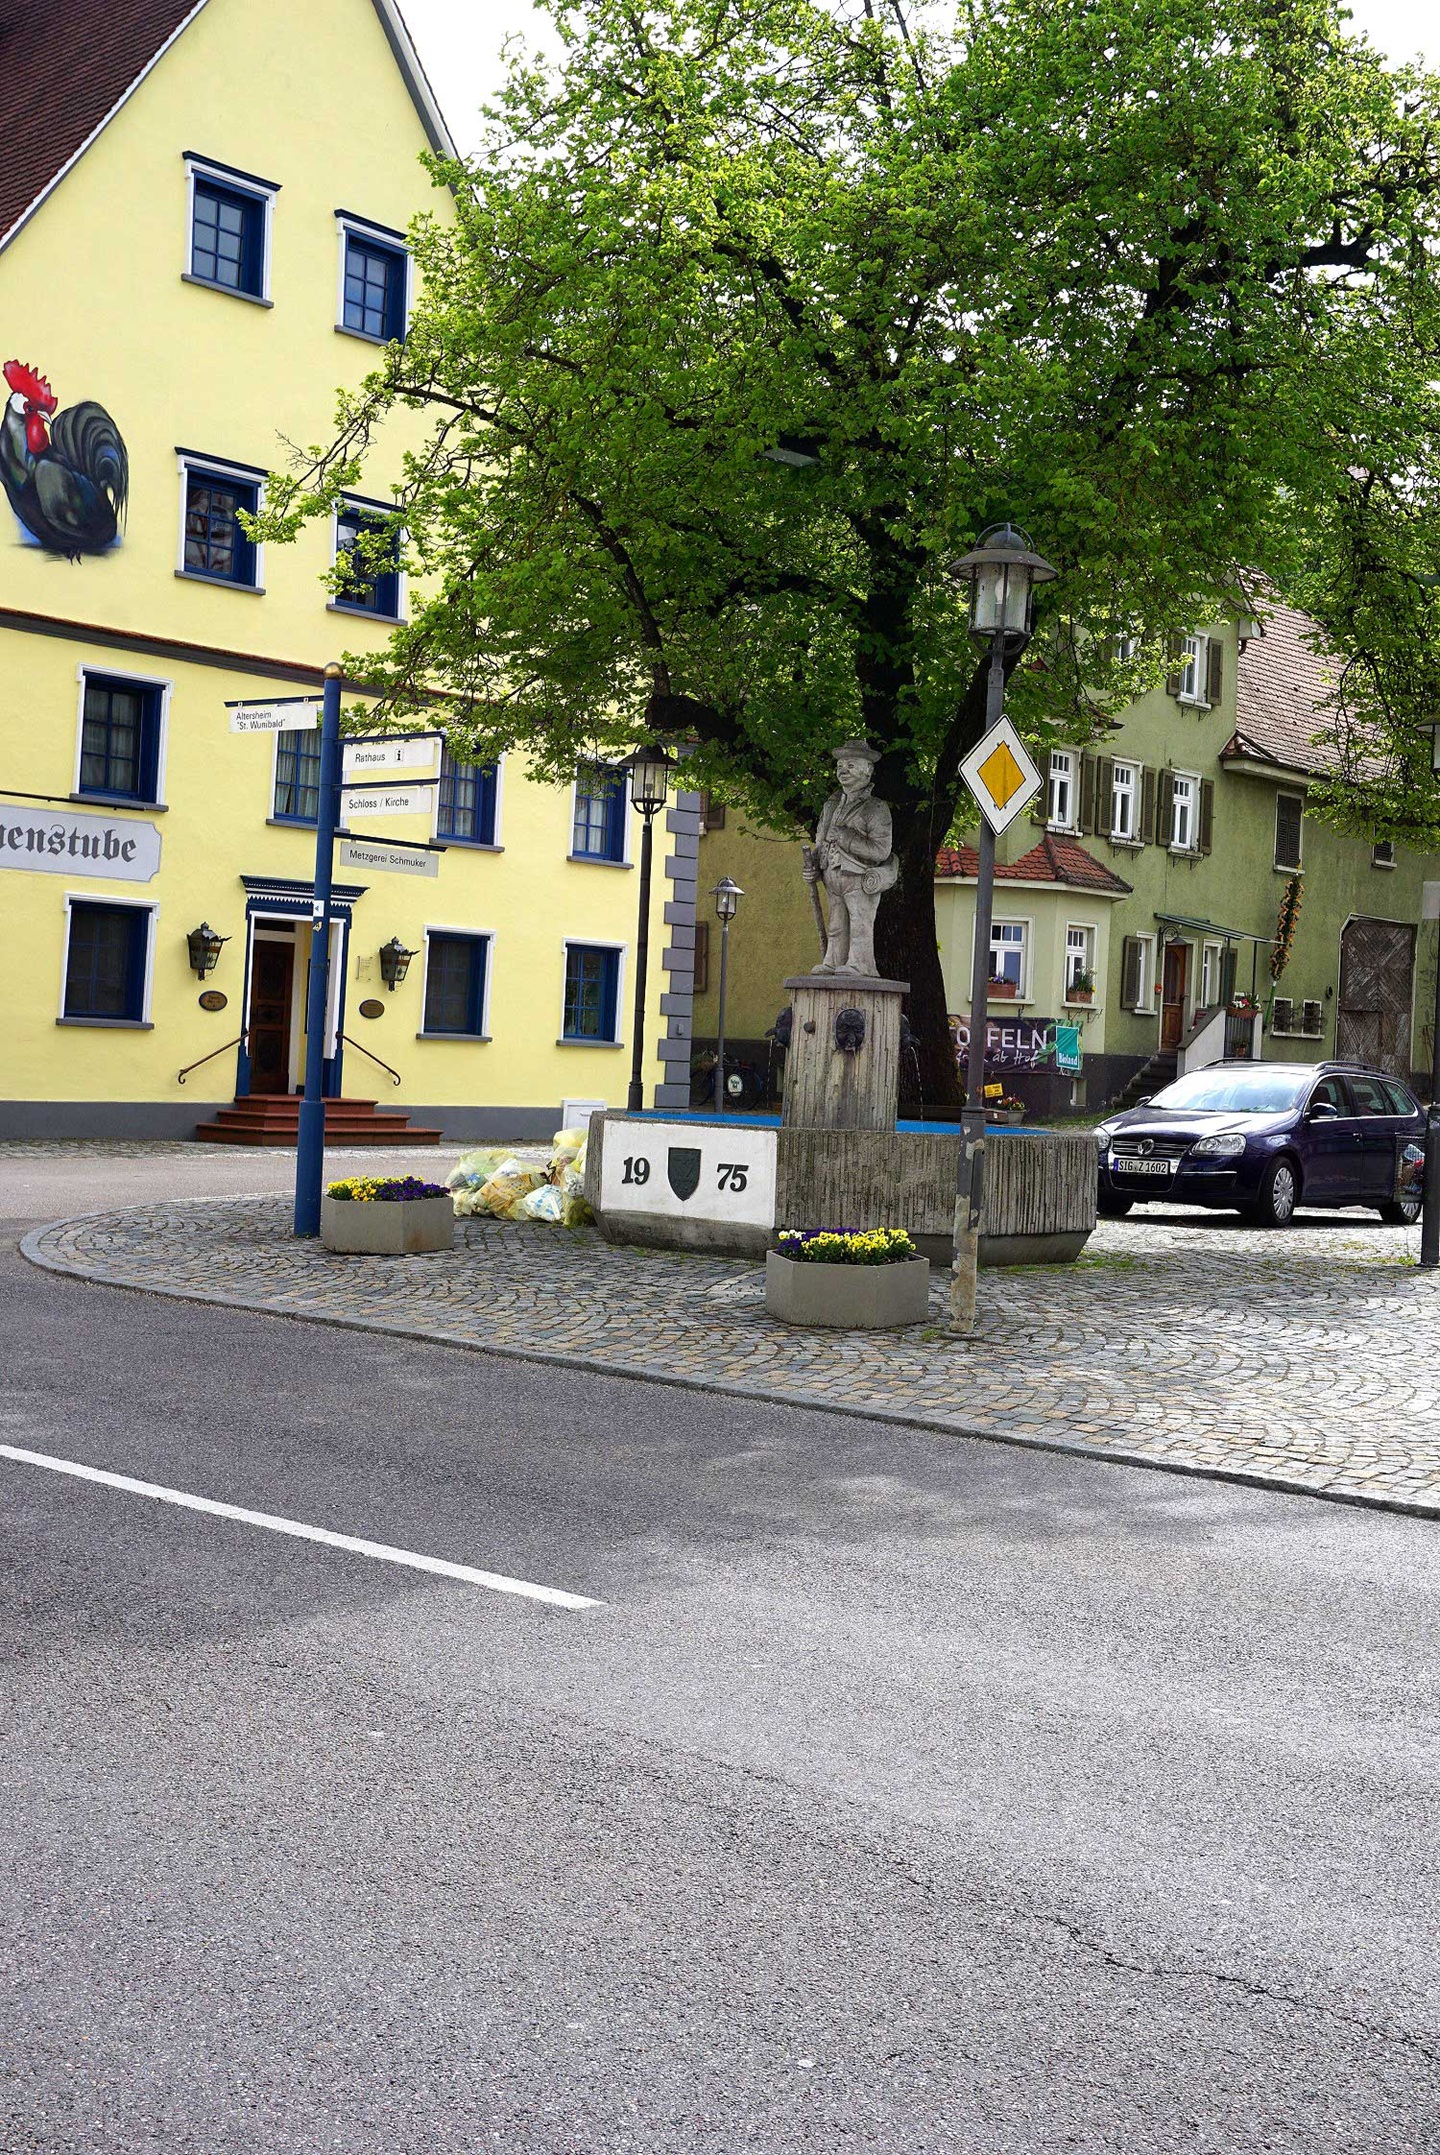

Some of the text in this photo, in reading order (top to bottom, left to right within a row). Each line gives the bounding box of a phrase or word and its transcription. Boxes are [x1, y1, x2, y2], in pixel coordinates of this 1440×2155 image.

[236, 709, 272, 721] Altersheim
[250, 718, 286, 730] Wunibald"
[355, 751, 386, 763] Rathaus
[348, 799, 377, 810] Schloss
[385, 798, 409, 807] Kirche
[349, 849, 427, 868] Metzgerei Schmuker
[1119, 1160, 1167, 1174] SIG Z 1602
[621, 1156, 750, 1193] 19 75
